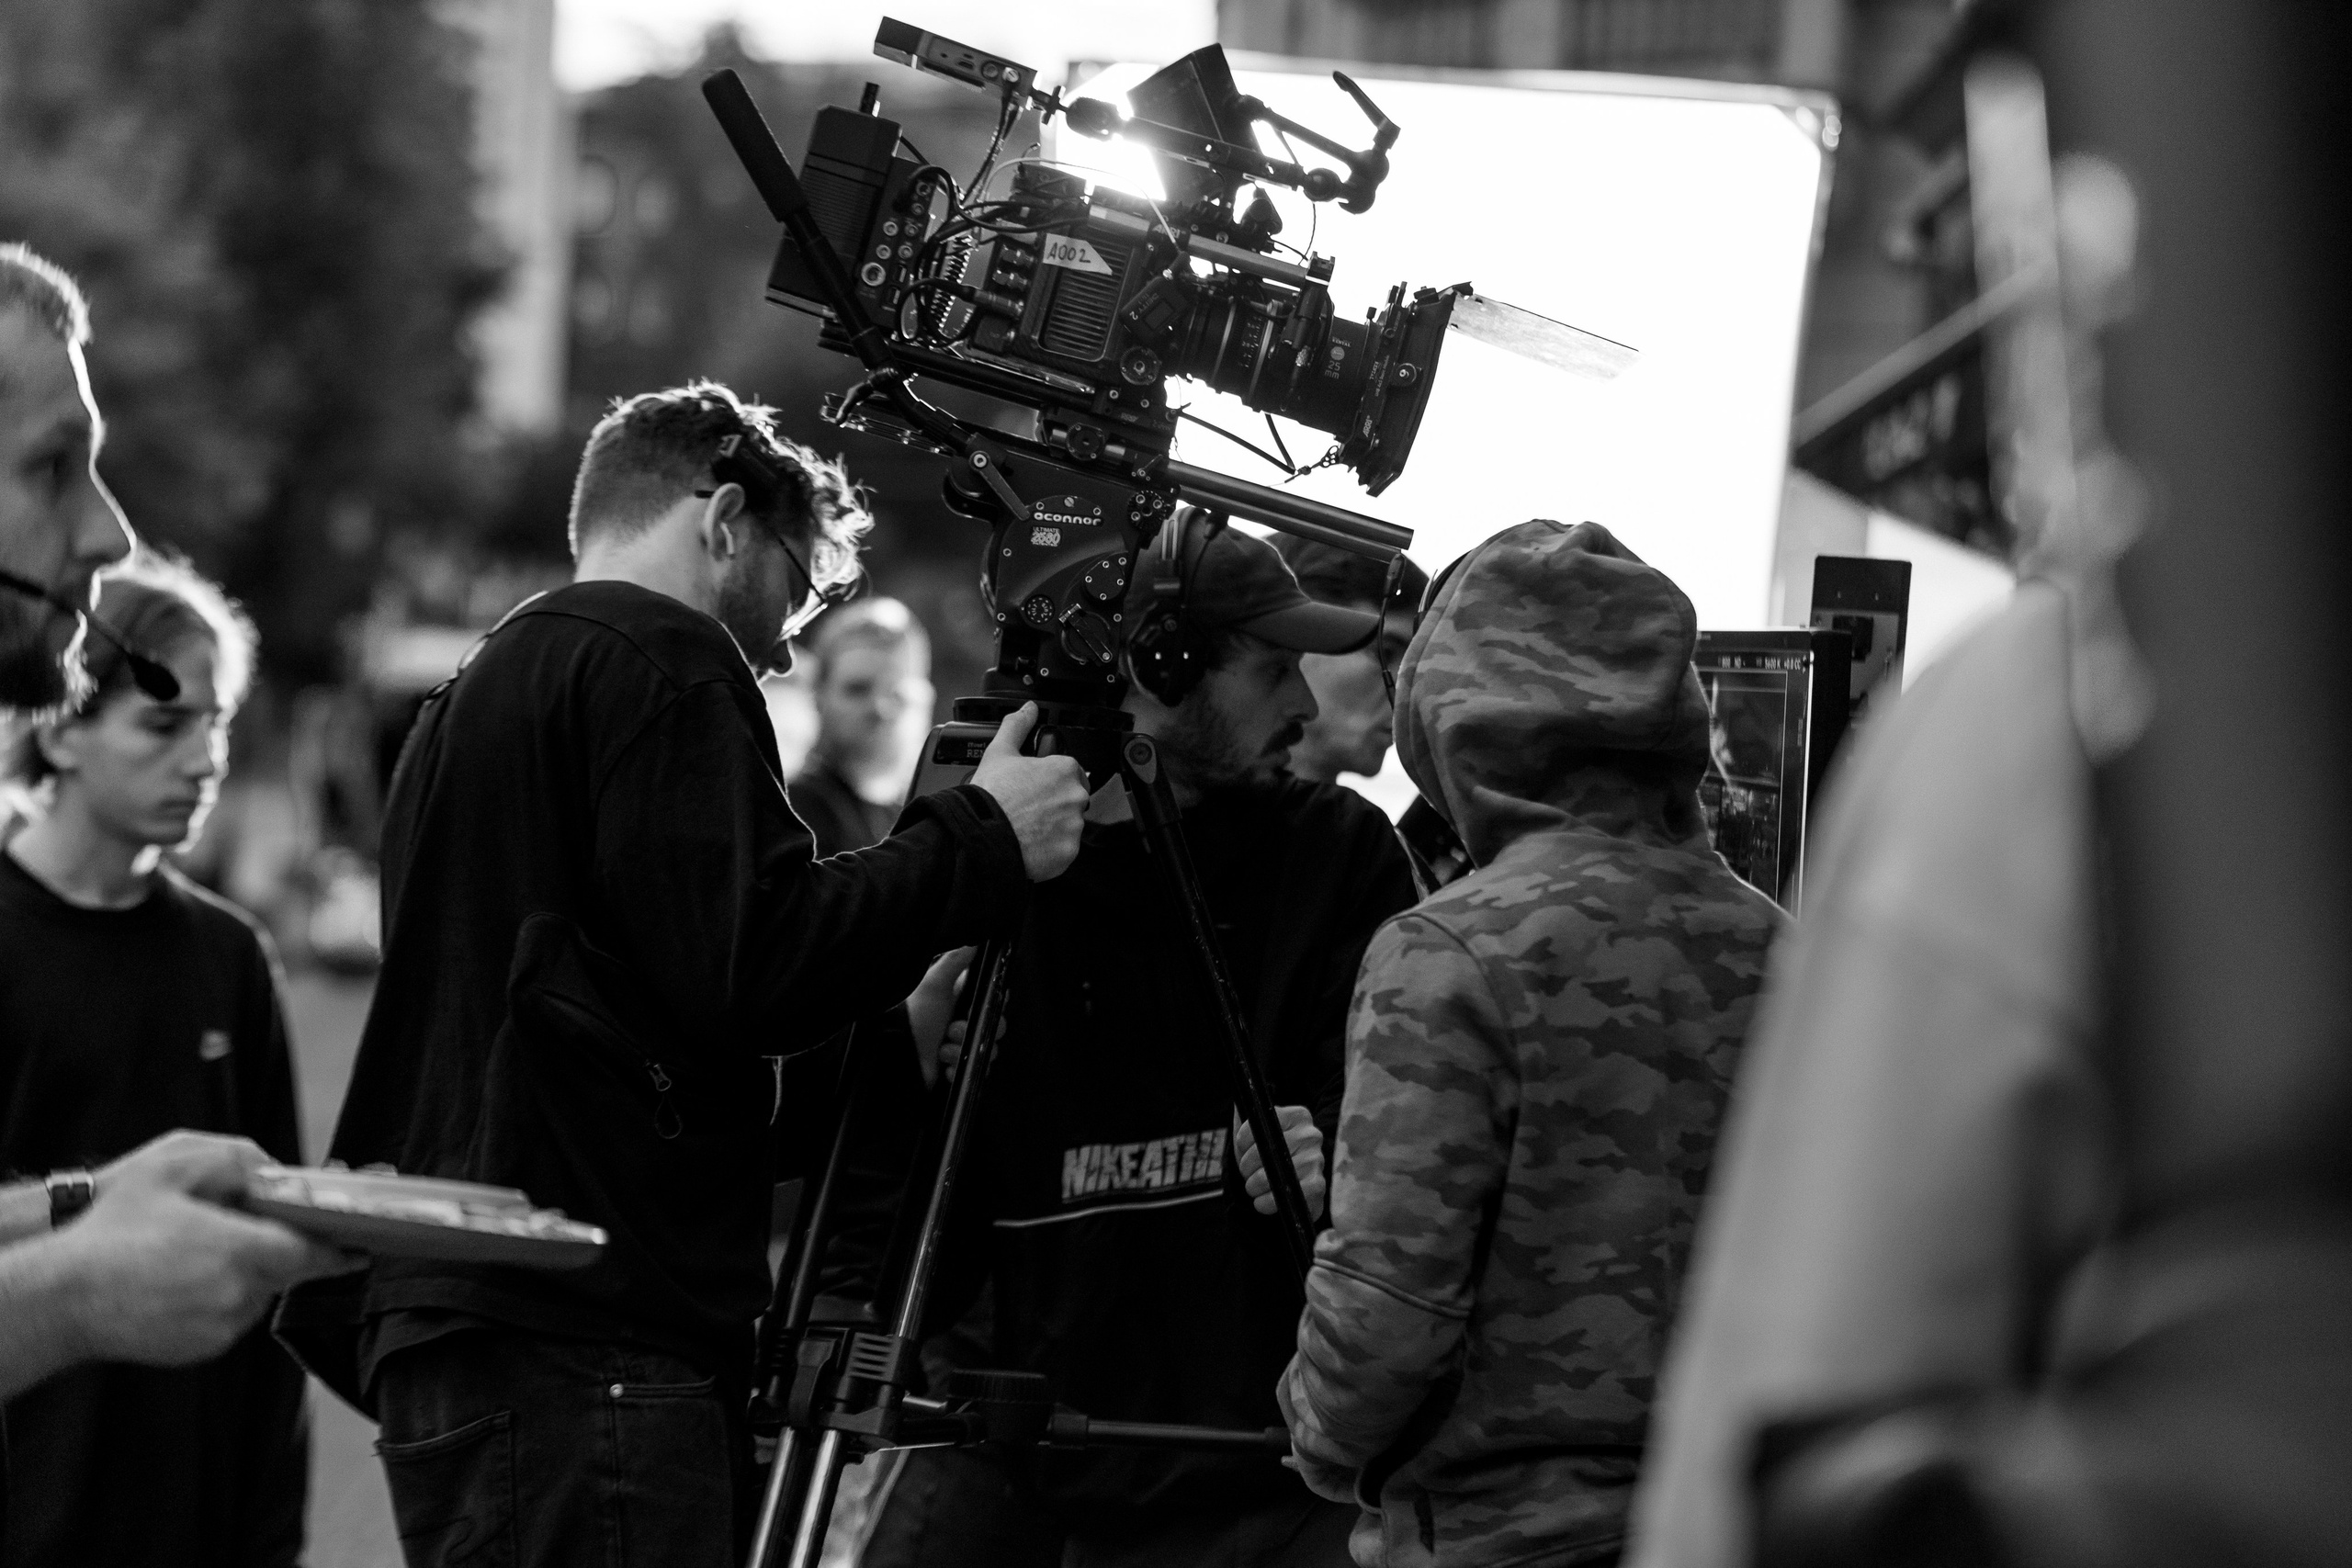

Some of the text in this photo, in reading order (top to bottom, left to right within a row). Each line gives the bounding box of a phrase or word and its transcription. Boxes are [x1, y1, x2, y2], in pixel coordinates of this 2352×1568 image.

[1047, 243, 1091, 264] A002
[1328, 360, 1340, 371] 25
[1324, 369, 1340, 379] mm
[1363, 420, 1373, 437] ARRI
